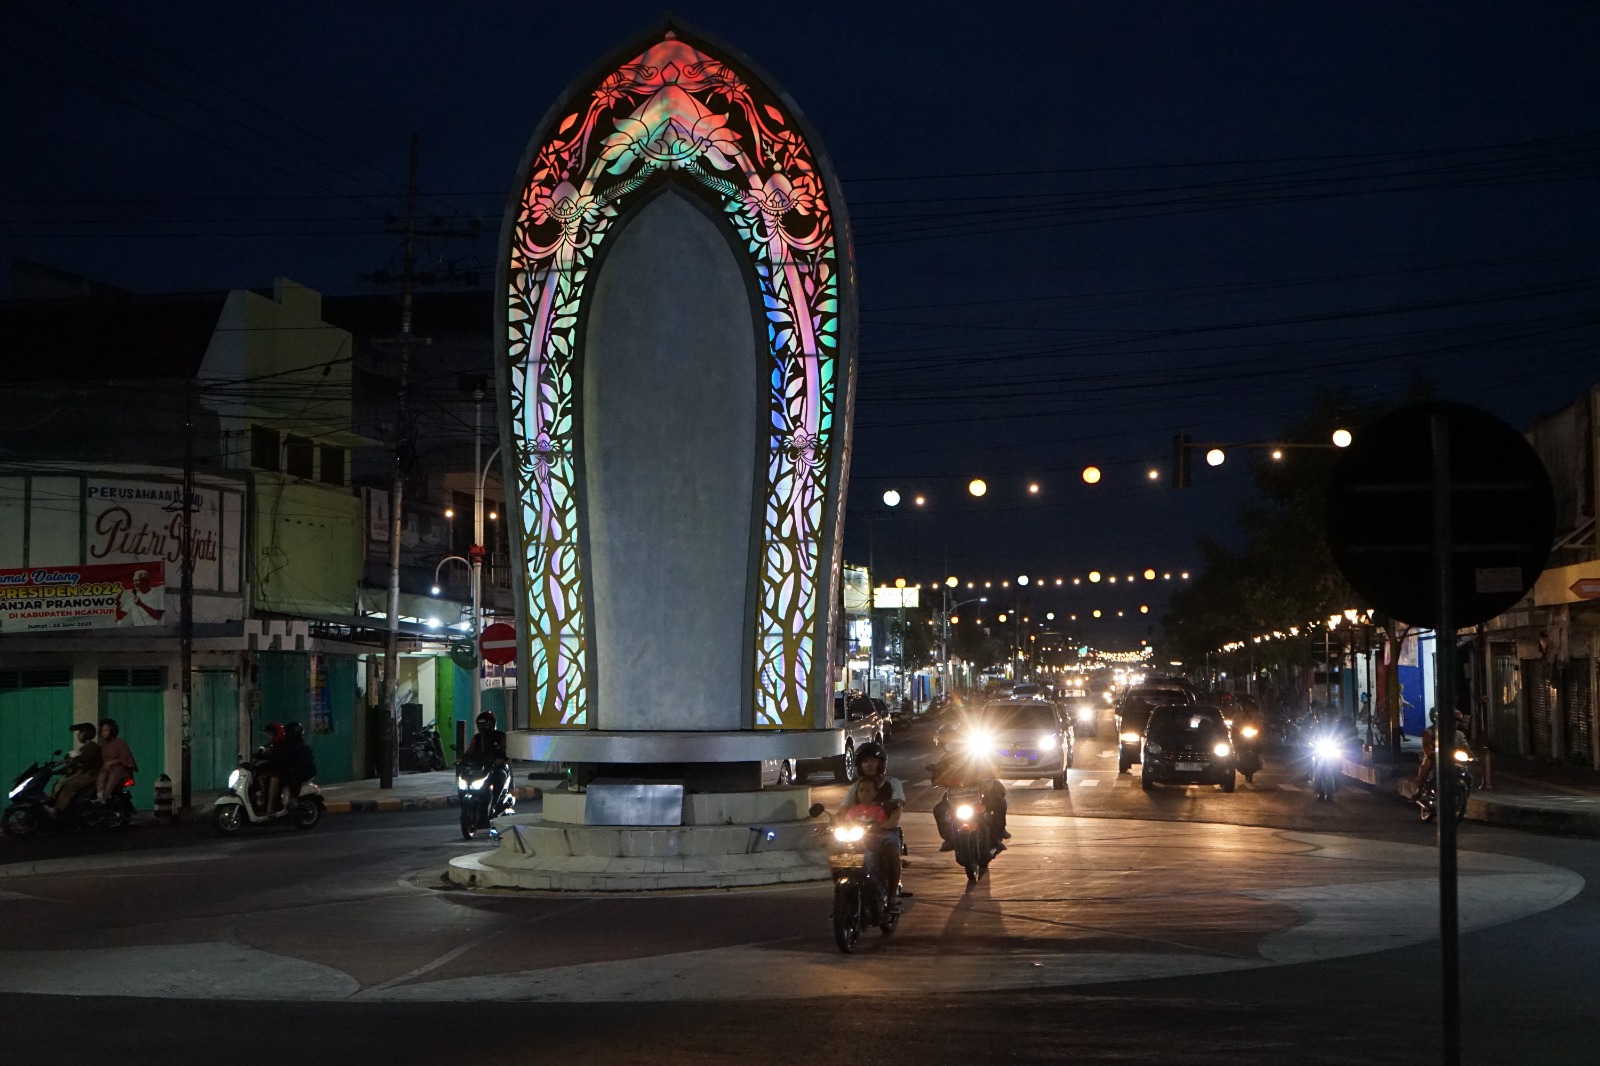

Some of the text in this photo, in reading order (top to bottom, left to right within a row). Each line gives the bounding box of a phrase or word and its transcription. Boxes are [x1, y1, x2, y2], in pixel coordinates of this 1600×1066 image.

[88, 486, 172, 501] PERUSAHAAN
[91, 506, 168, 558] Putri
[32, 570, 80, 584] Datang
[82, 583, 123, 596] 2024
[46, 598, 115, 609] PRANOWO
[20, 610, 72, 619] KABUPATEN
[75, 608, 115, 616] NGANJUK
